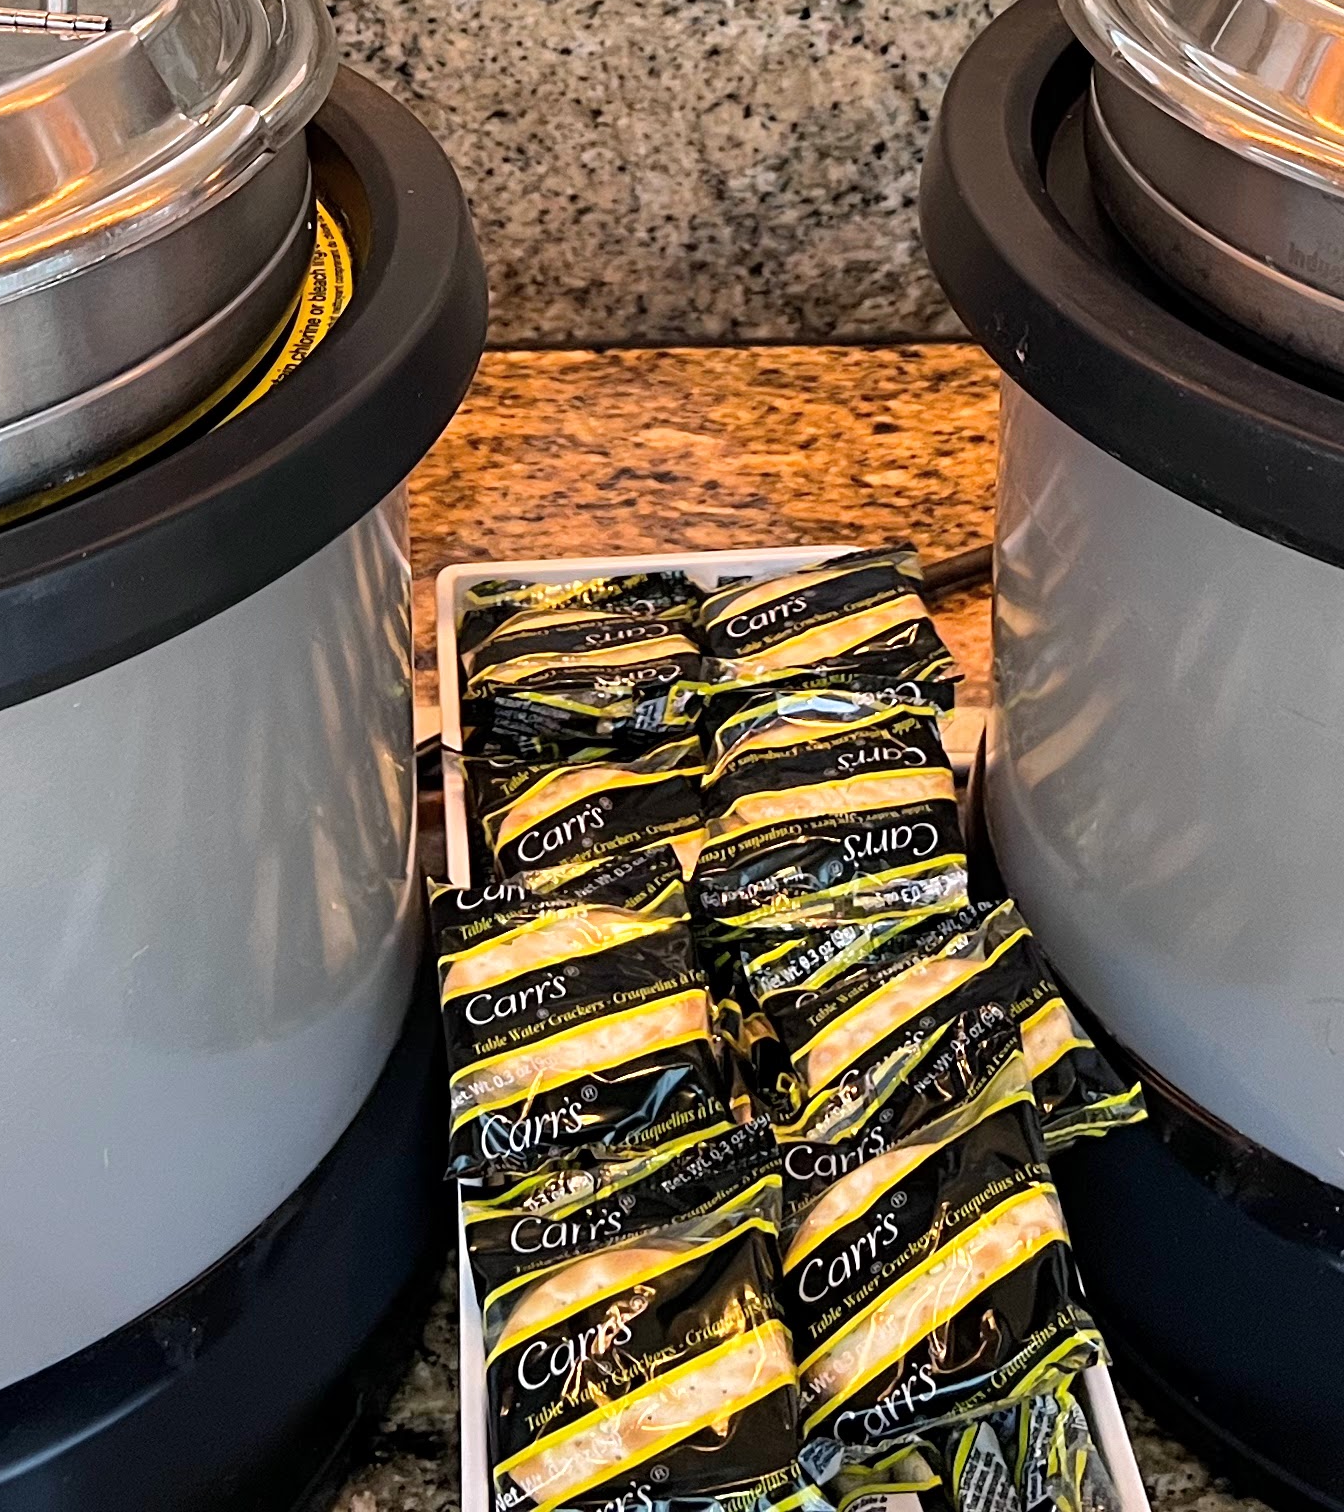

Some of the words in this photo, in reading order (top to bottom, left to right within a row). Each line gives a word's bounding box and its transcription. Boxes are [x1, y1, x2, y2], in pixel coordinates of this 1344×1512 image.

[307, 268, 327, 302] bleach
[309, 303, 324, 317] or
[289, 316, 323, 361] chlorine
[726, 595, 807, 638] Carr's
[837, 746, 927, 772] Carr's
[517, 803, 605, 862] Carr's
[593, 830, 642, 855] Crackers
[843, 823, 939, 867] Carr's
[465, 972, 567, 1026] Carr's
[472, 1033, 507, 1056] Table
[508, 1018, 547, 1042] Water
[547, 999, 606, 1027] Crackers
[494, 1068, 515, 1089] 0.3
[481, 1096, 583, 1160] Carr's
[625, 1109, 696, 1148] Craquelins
[784, 1125, 885, 1180] Carr's
[510, 1207, 622, 1253] Carr's
[798, 1212, 899, 1303] Carr's
[807, 1307, 843, 1340] Table
[843, 1274, 880, 1309] Water
[945, 1176, 1014, 1227] Craquelins
[1015, 1167, 1026, 1183] à
[990, 1328, 1057, 1390] Craquelins
[524, 1401, 564, 1433] Table
[833, 1362, 937, 1440] Carr's
